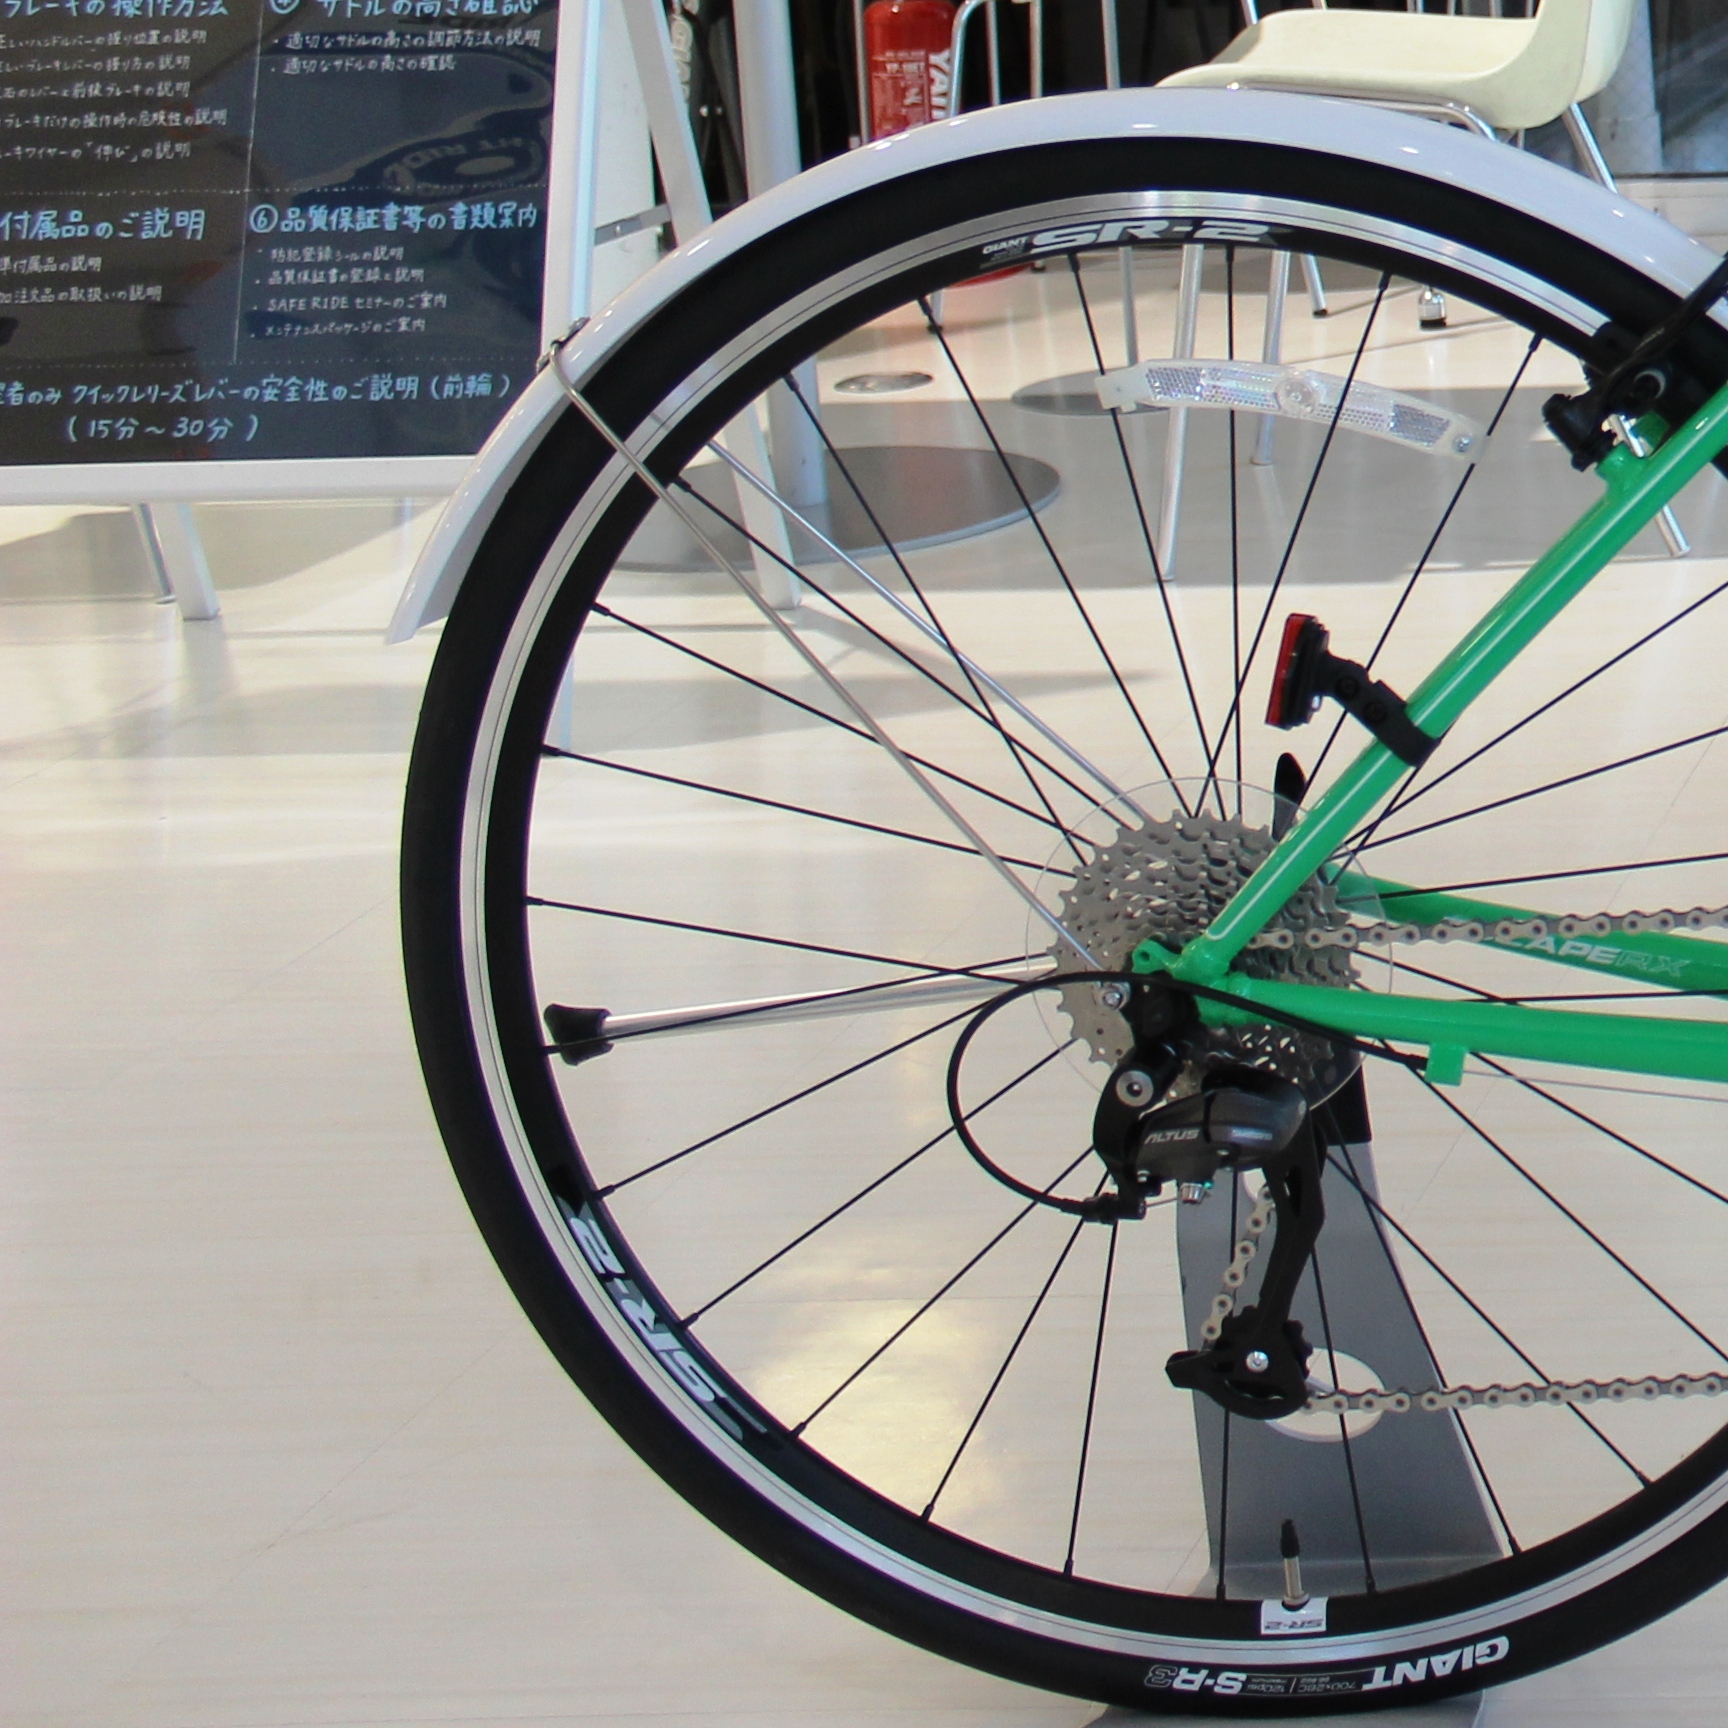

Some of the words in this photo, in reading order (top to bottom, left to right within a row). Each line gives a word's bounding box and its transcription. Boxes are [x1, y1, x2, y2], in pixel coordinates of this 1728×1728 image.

[982, 235, 1030, 256] GIANT
[1030, 219, 1271, 255] SR-2
[267, 298, 307, 313] SAFE
[311, 296, 350, 311] RIDE
[1144, 1127, 1200, 1146] ALTUS
[1363, 1636, 1510, 1691] GIANT
